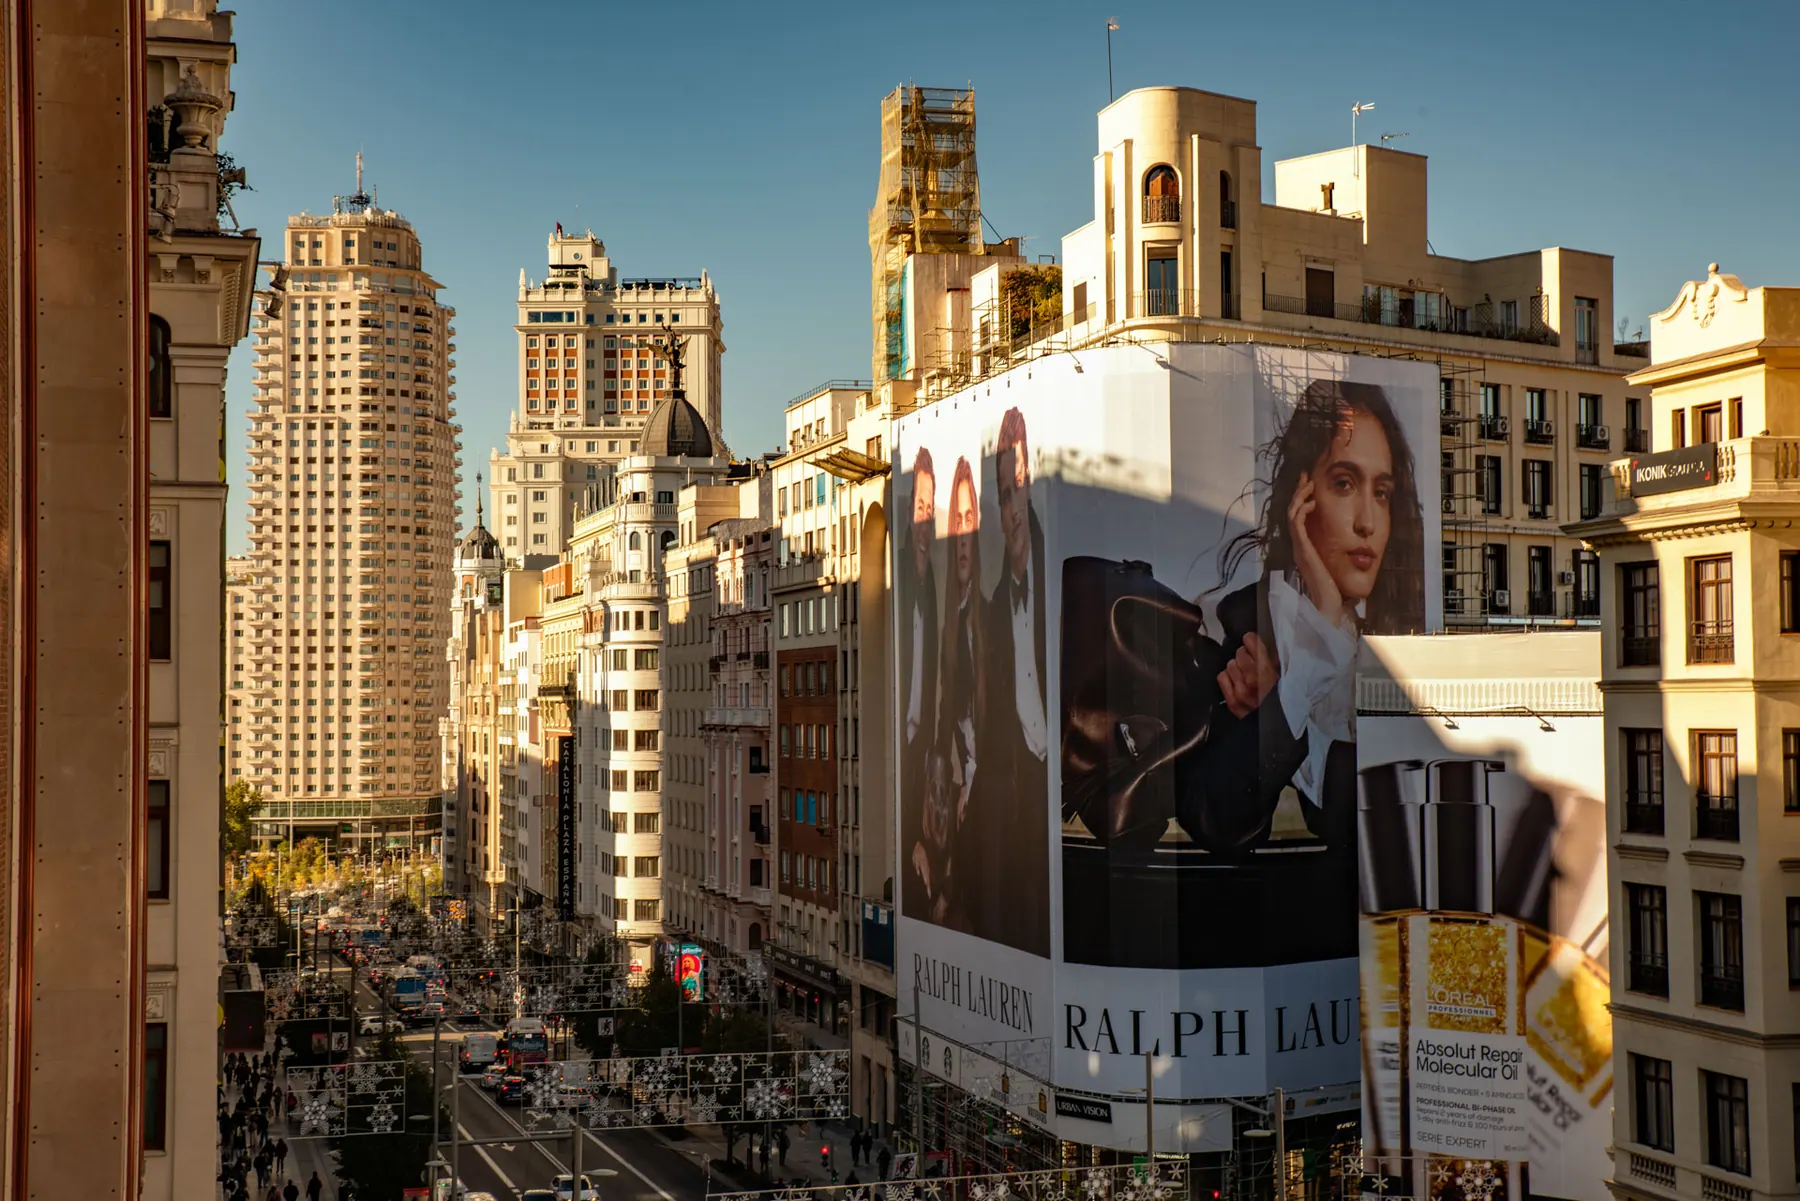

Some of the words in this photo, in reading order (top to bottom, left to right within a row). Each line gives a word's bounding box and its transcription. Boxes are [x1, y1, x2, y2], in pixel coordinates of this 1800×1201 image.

[1636, 463, 1668, 483] IKONIK
[562, 741, 571, 810] CATALONIA
[562, 815, 571, 854] PLAZA
[562, 858, 571, 905] ESPAÑA
[913, 952, 962, 1007] RALPH
[967, 970, 1033, 1036] LAUREN
[1427, 1005, 1495, 1017] PROFESSIONNEL
[1063, 1003, 1251, 1058] RALPH
[1276, 996, 1361, 1053] LAU
[1415, 1038, 1477, 1060] Absolut
[1480, 1045, 1524, 1066] Repair
[1415, 1055, 1498, 1079] Molecular
[1501, 1064, 1519, 1081] Oil
[1082, 1104, 1109, 1117] VISION
[1416, 1096, 1470, 1111] PROFESSIONAL
[1471, 1103, 1506, 1114] BI-PHASE
[1446, 1111, 1467, 1121] years
[1467, 1112, 1476, 1121] of
[1475, 1121, 1489, 1130] 100
[1416, 1130, 1443, 1145] SERIE
[1445, 1134, 1488, 1149] EXPERT
